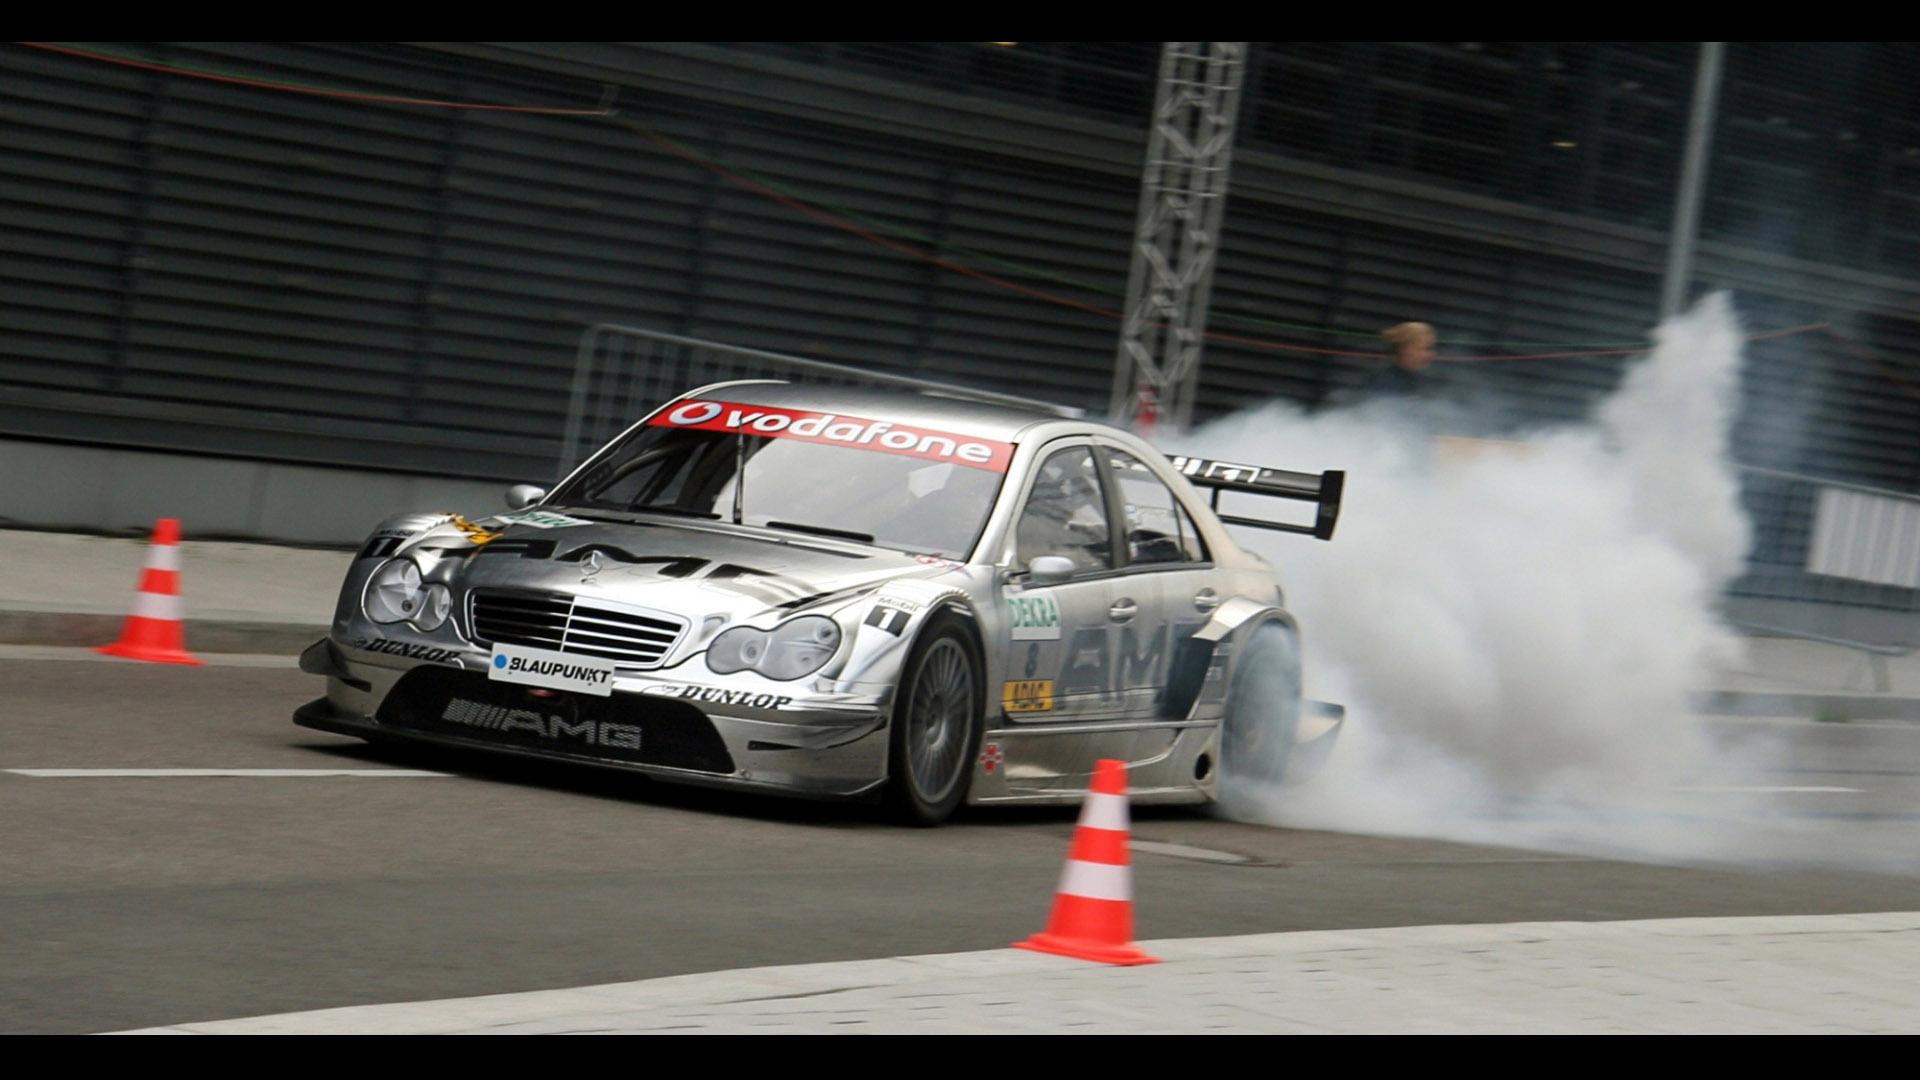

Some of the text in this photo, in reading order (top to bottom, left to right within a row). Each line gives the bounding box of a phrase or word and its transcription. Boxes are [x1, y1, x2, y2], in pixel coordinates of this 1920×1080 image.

[724, 407, 993, 464] vodafone
[880, 597, 919, 613] Mobil
[878, 608, 898, 630] 1
[365, 639, 461, 662] DUNLOP
[508, 657, 612, 684] BLAUPUNKT
[679, 685, 793, 710] DUNLOP
[500, 708, 642, 750] AMG
